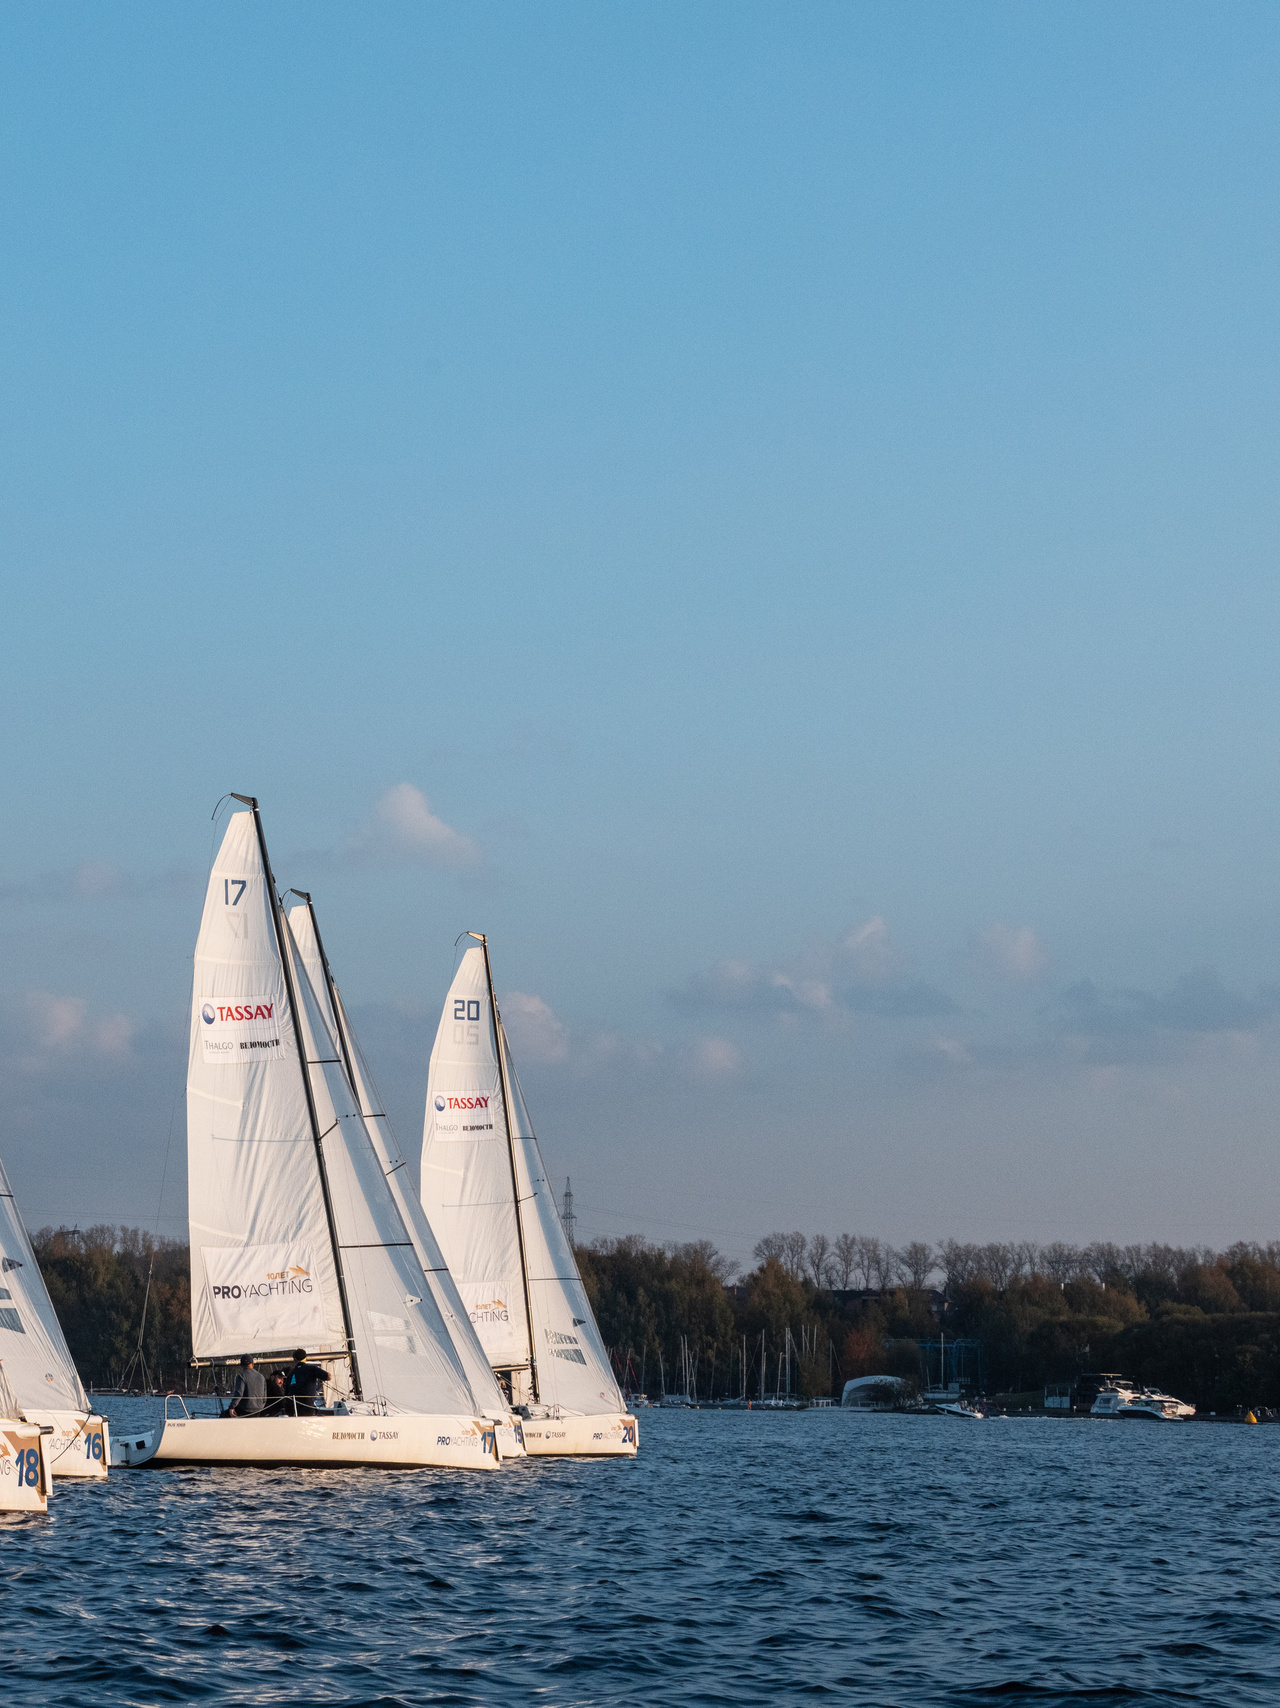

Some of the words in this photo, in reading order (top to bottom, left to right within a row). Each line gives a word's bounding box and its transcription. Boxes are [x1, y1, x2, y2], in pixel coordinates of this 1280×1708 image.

[224, 878, 247, 906] 17
[216, 1003, 274, 1021] TASSAY
[453, 999, 480, 1021] 20
[204, 1040, 234, 1050] THALGO
[239, 1039, 280, 1050] ВЕДОМОСТИ
[447, 1096, 490, 1109] TASSAY
[435, 1122, 459, 1131] THALGO
[212, 1278, 313, 1299] PROYACHTING
[469, 1310, 509, 1324] CHTING
[378, 1431, 400, 1440] TASSAY
[480, 1432, 495, 1454] 17
[621, 1425, 635, 1443] 20
[84, 1432, 102, 1460] 16
[15, 1448, 39, 1487] 18
